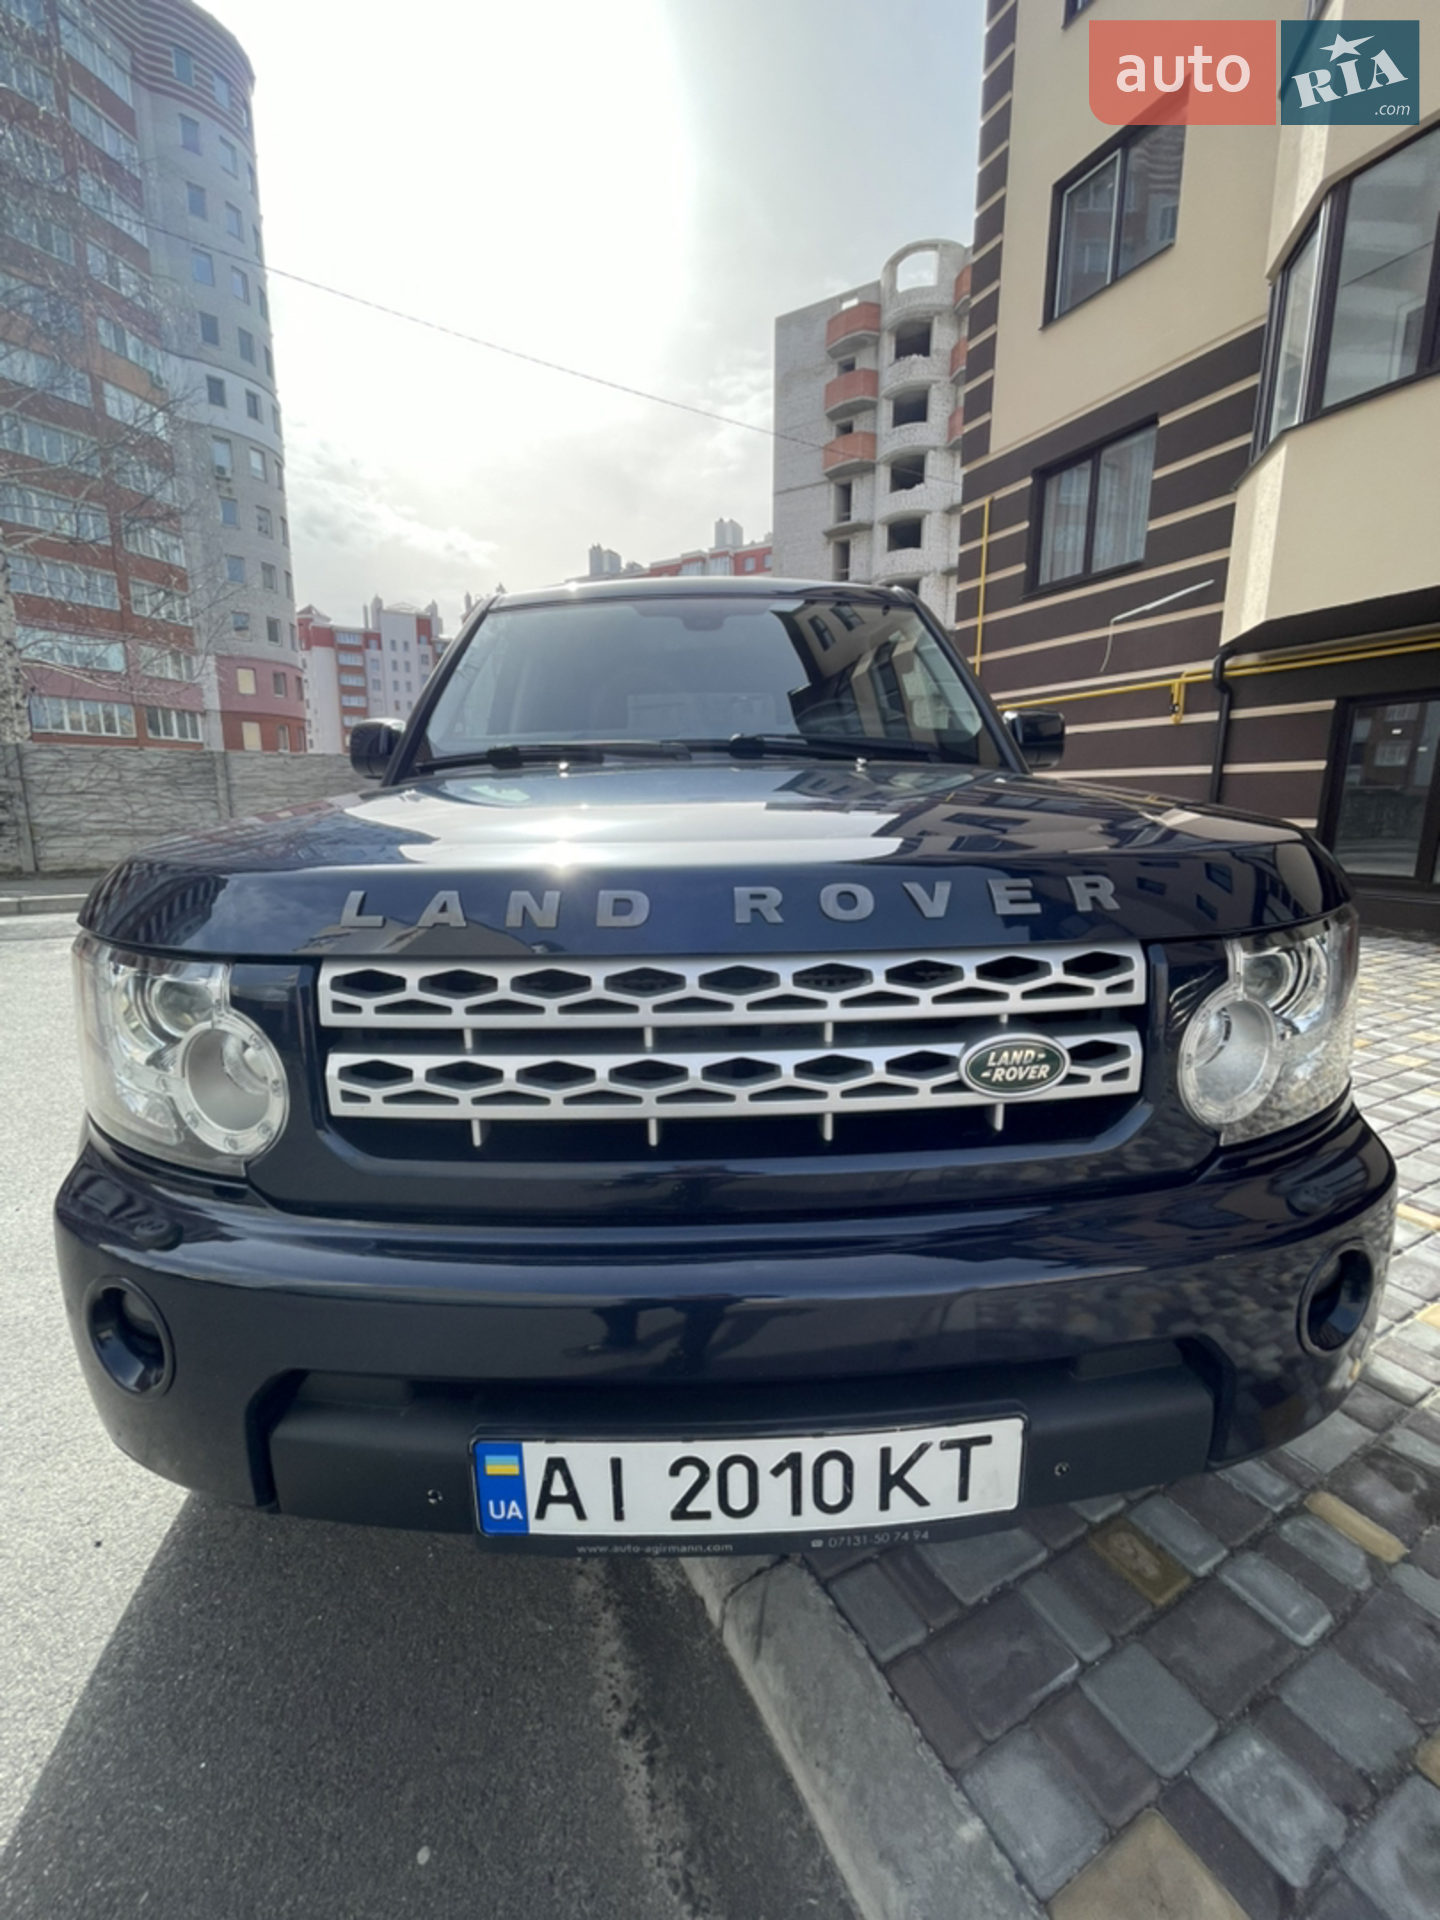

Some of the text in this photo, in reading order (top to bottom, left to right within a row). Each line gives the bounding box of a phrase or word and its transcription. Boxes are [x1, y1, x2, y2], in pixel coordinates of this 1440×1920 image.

[340, 875, 1120, 928] LAND ROVER
[987, 1049, 1035, 1066] LAND
[992, 1064, 1050, 1082] ROVER
[535, 1434, 993, 1521] AI 2010 KT
[488, 1500, 523, 1520] UA
